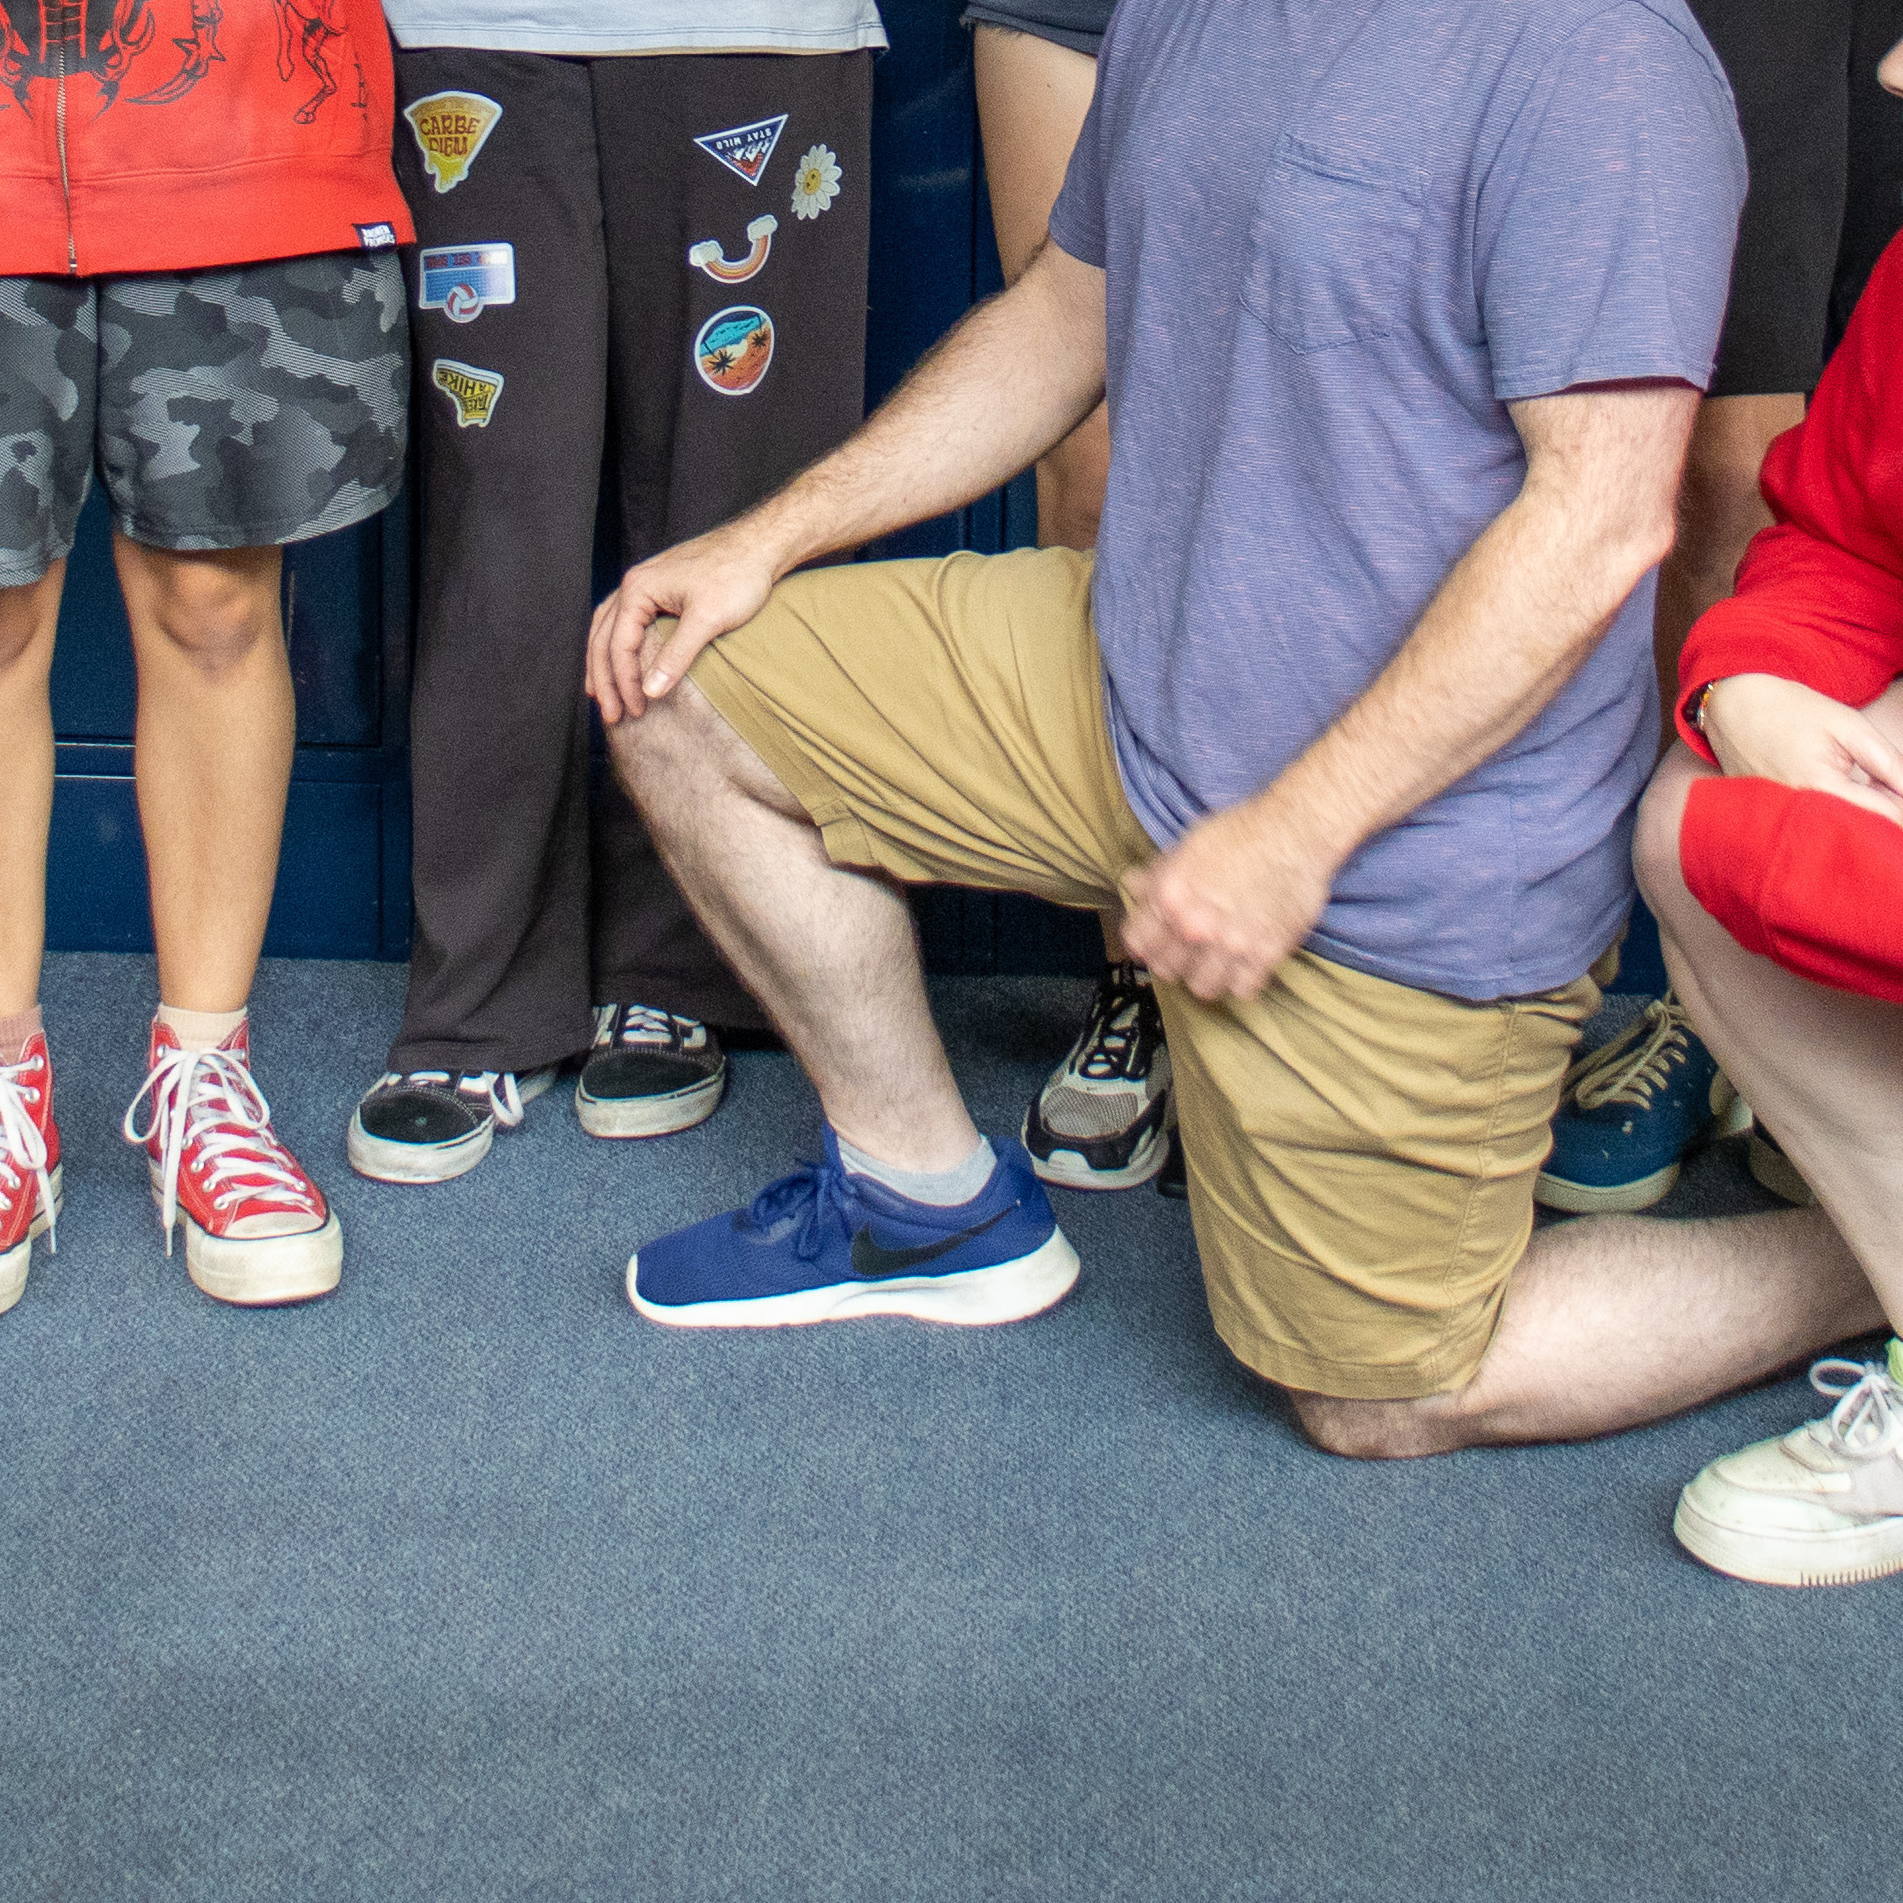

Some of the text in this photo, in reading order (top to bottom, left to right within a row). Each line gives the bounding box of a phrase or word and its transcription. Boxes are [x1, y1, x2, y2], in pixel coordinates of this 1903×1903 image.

[420, 114, 481, 135] CARBE
[747, 128, 772, 143] STAY
[438, 371, 476, 396] HIKE
